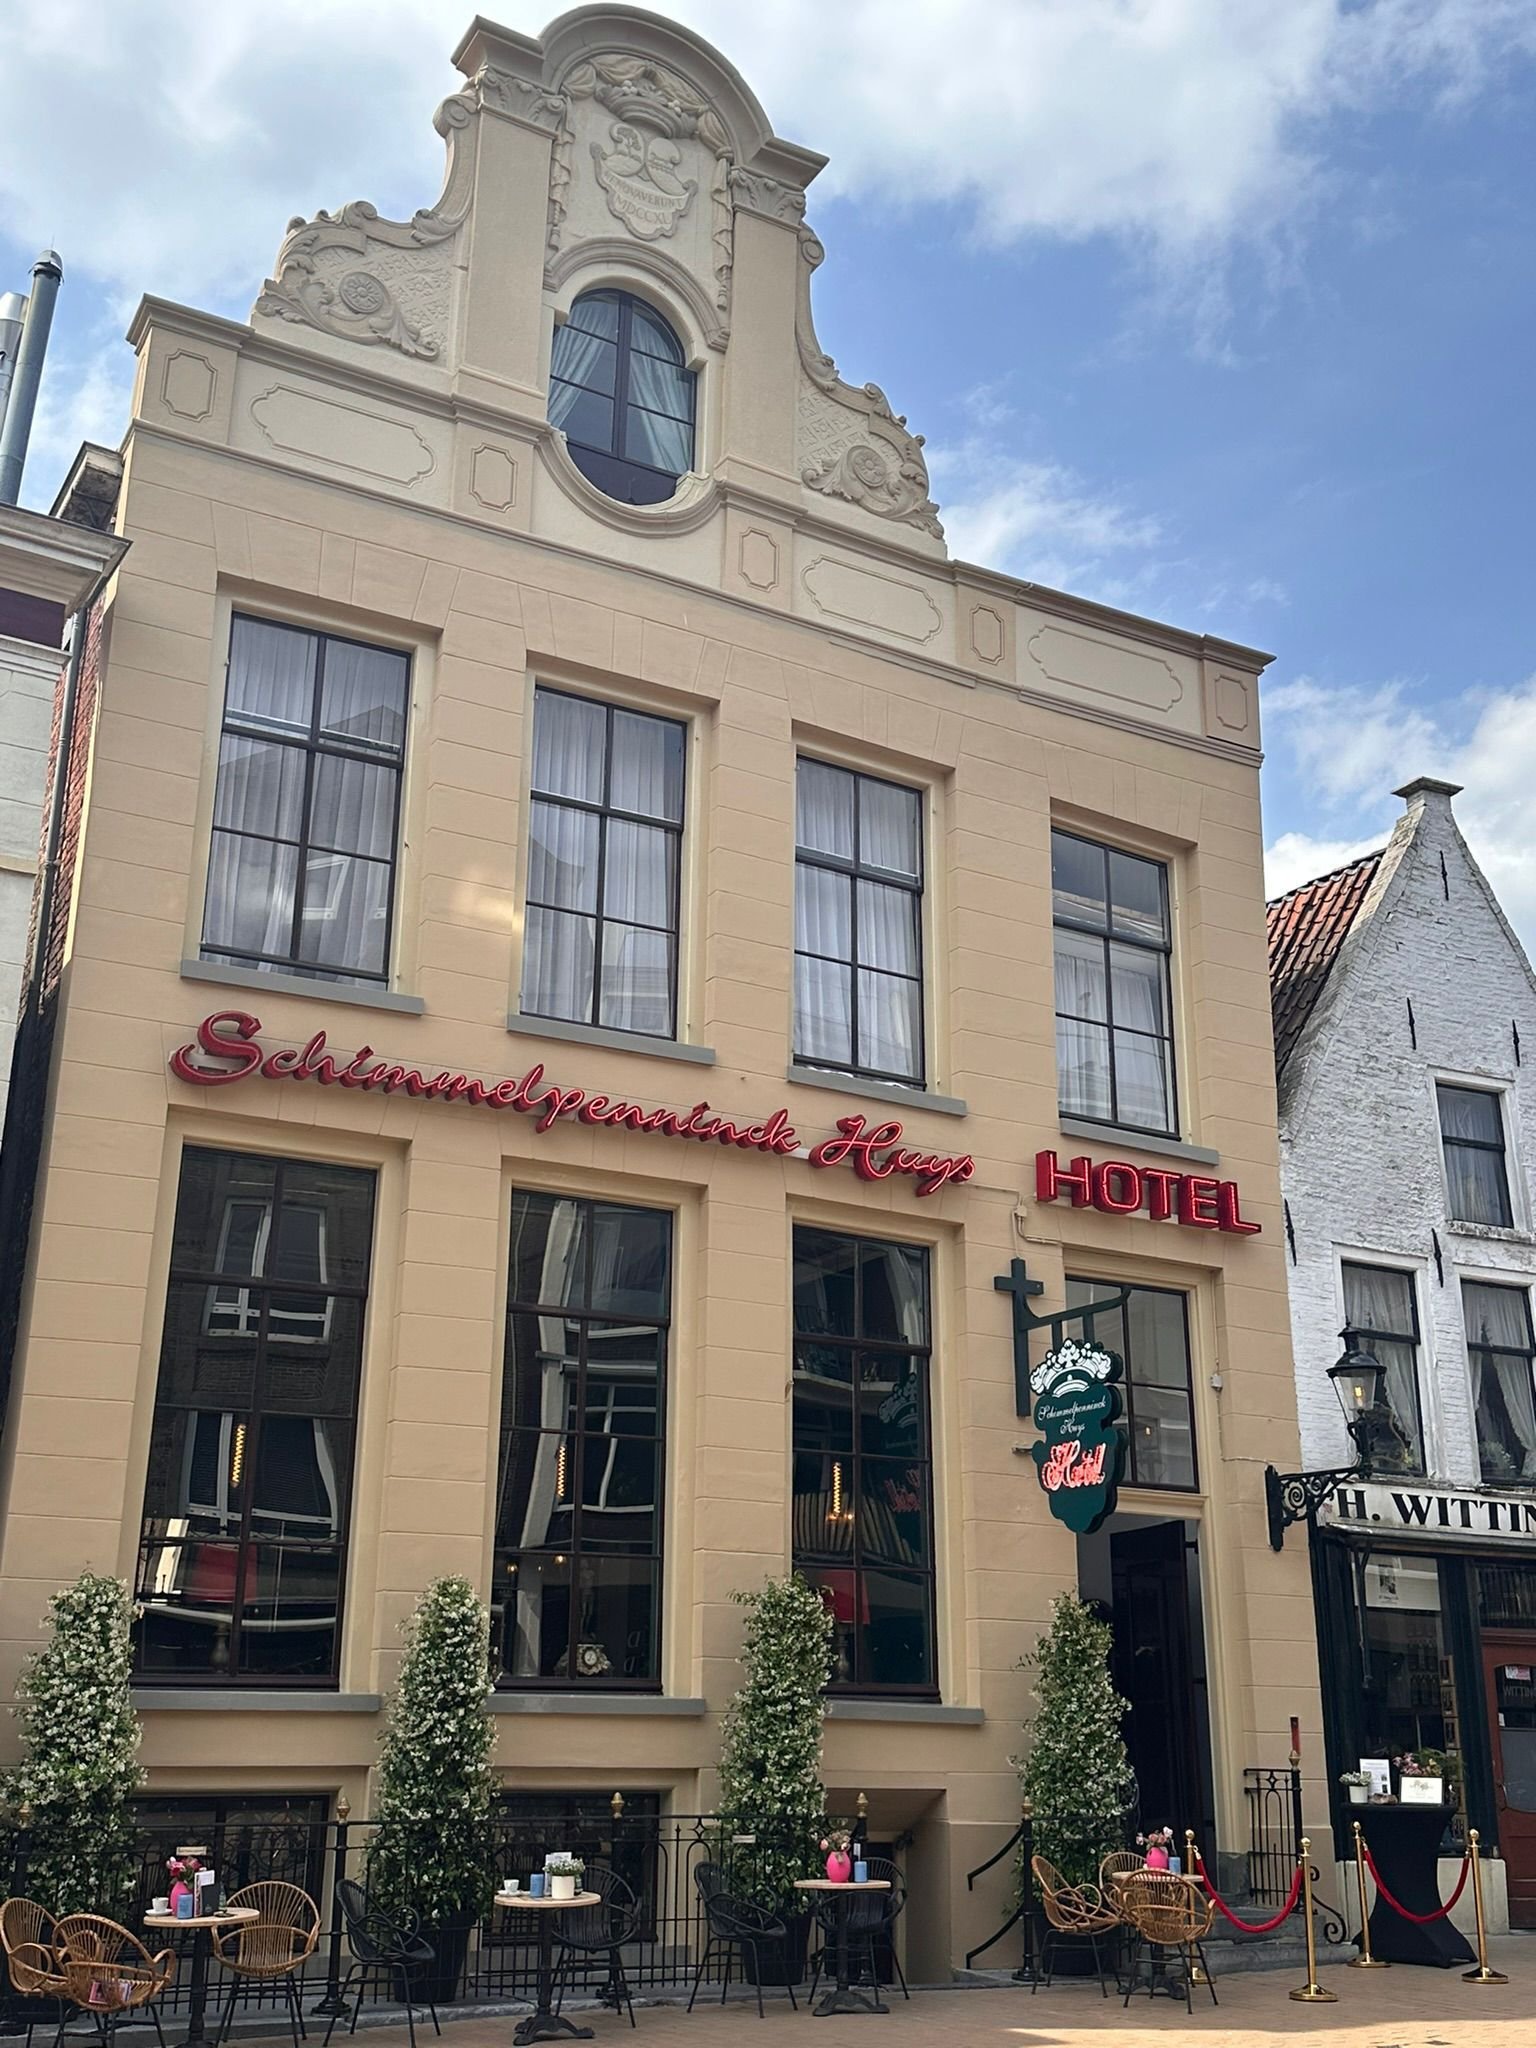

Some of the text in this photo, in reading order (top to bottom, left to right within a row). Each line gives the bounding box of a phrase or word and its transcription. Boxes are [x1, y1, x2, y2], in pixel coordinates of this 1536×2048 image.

[169, 1009, 976, 1197] Schimmelpenninck Huys
[1035, 1149, 1262, 1235] HOTEL
[1038, 1396, 1106, 1422] Schimmelpenninck
[1060, 1418, 1086, 1437] Huys
[1041, 1440, 1106, 1491] Hotel
